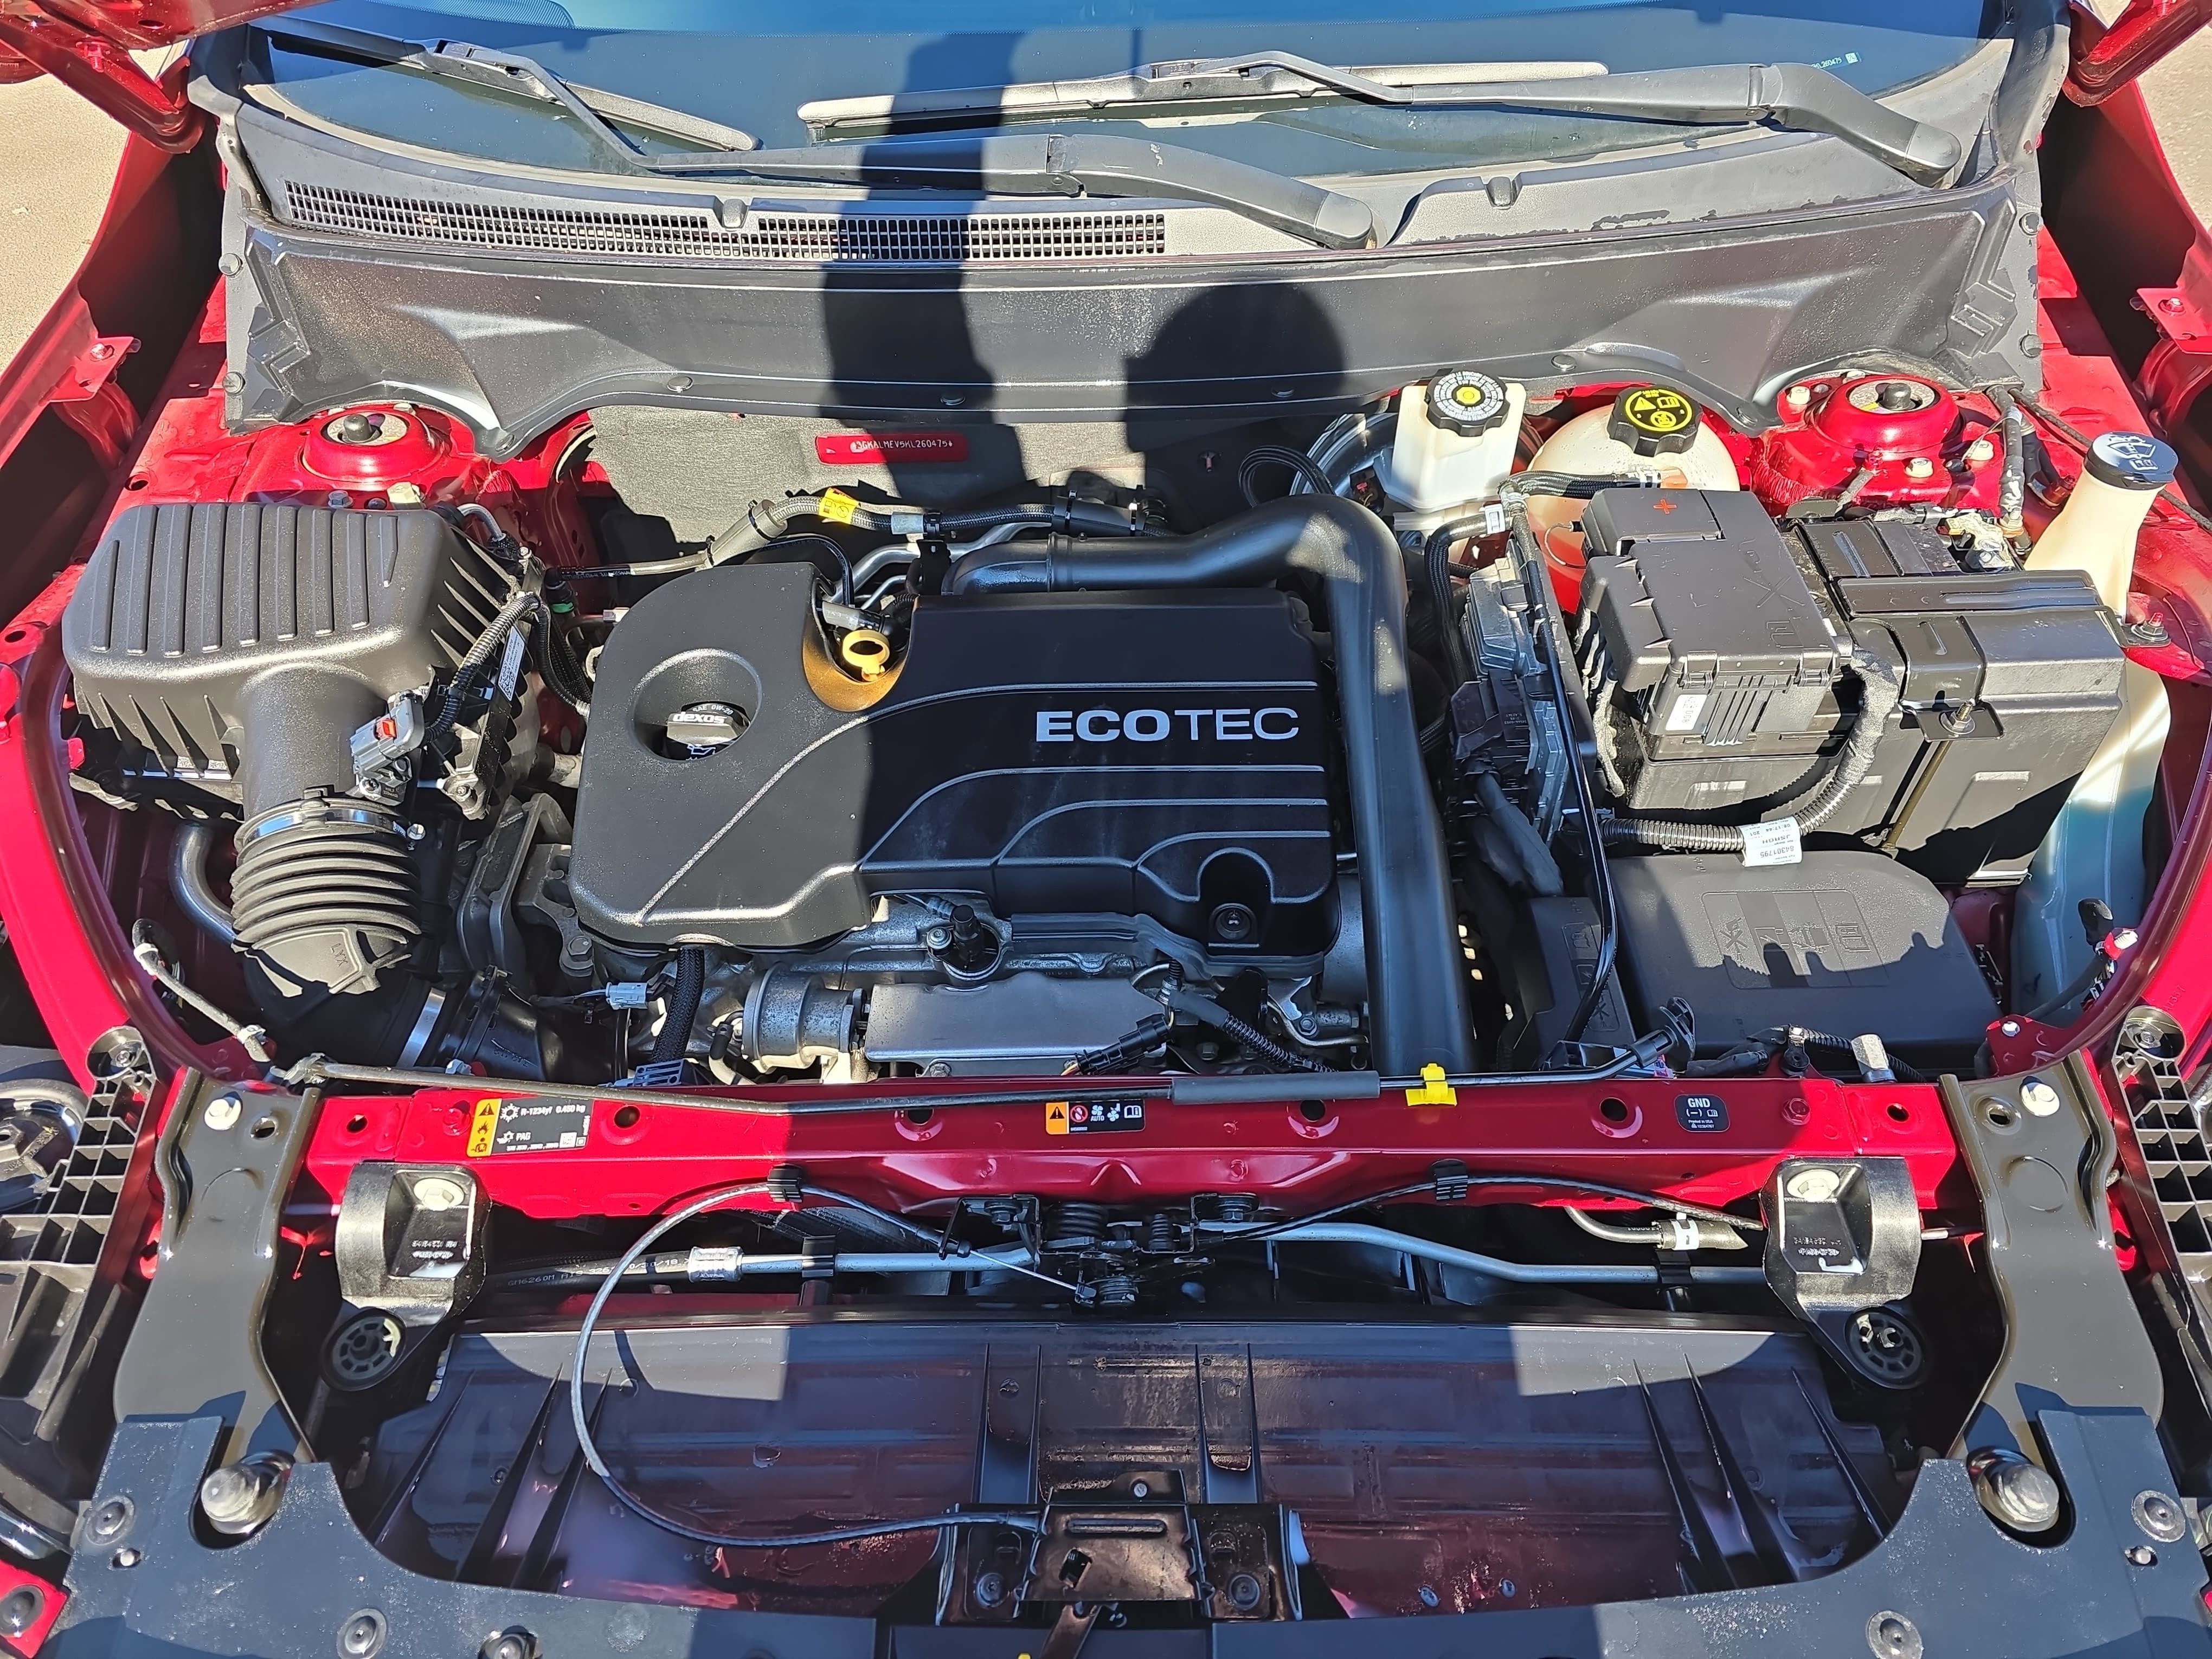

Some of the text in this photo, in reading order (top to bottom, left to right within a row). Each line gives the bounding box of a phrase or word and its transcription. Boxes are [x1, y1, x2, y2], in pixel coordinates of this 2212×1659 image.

[711, 704, 734, 715] 0W-20
[672, 711, 727, 724] dexos
[1036, 707, 1299, 742] ECOTEC
[1687, 1098, 1711, 1108] GND
[520, 1107, 553, 1117] R-1234yf
[576, 1104, 586, 1113] kg
[516, 1132, 531, 1141] PAG
